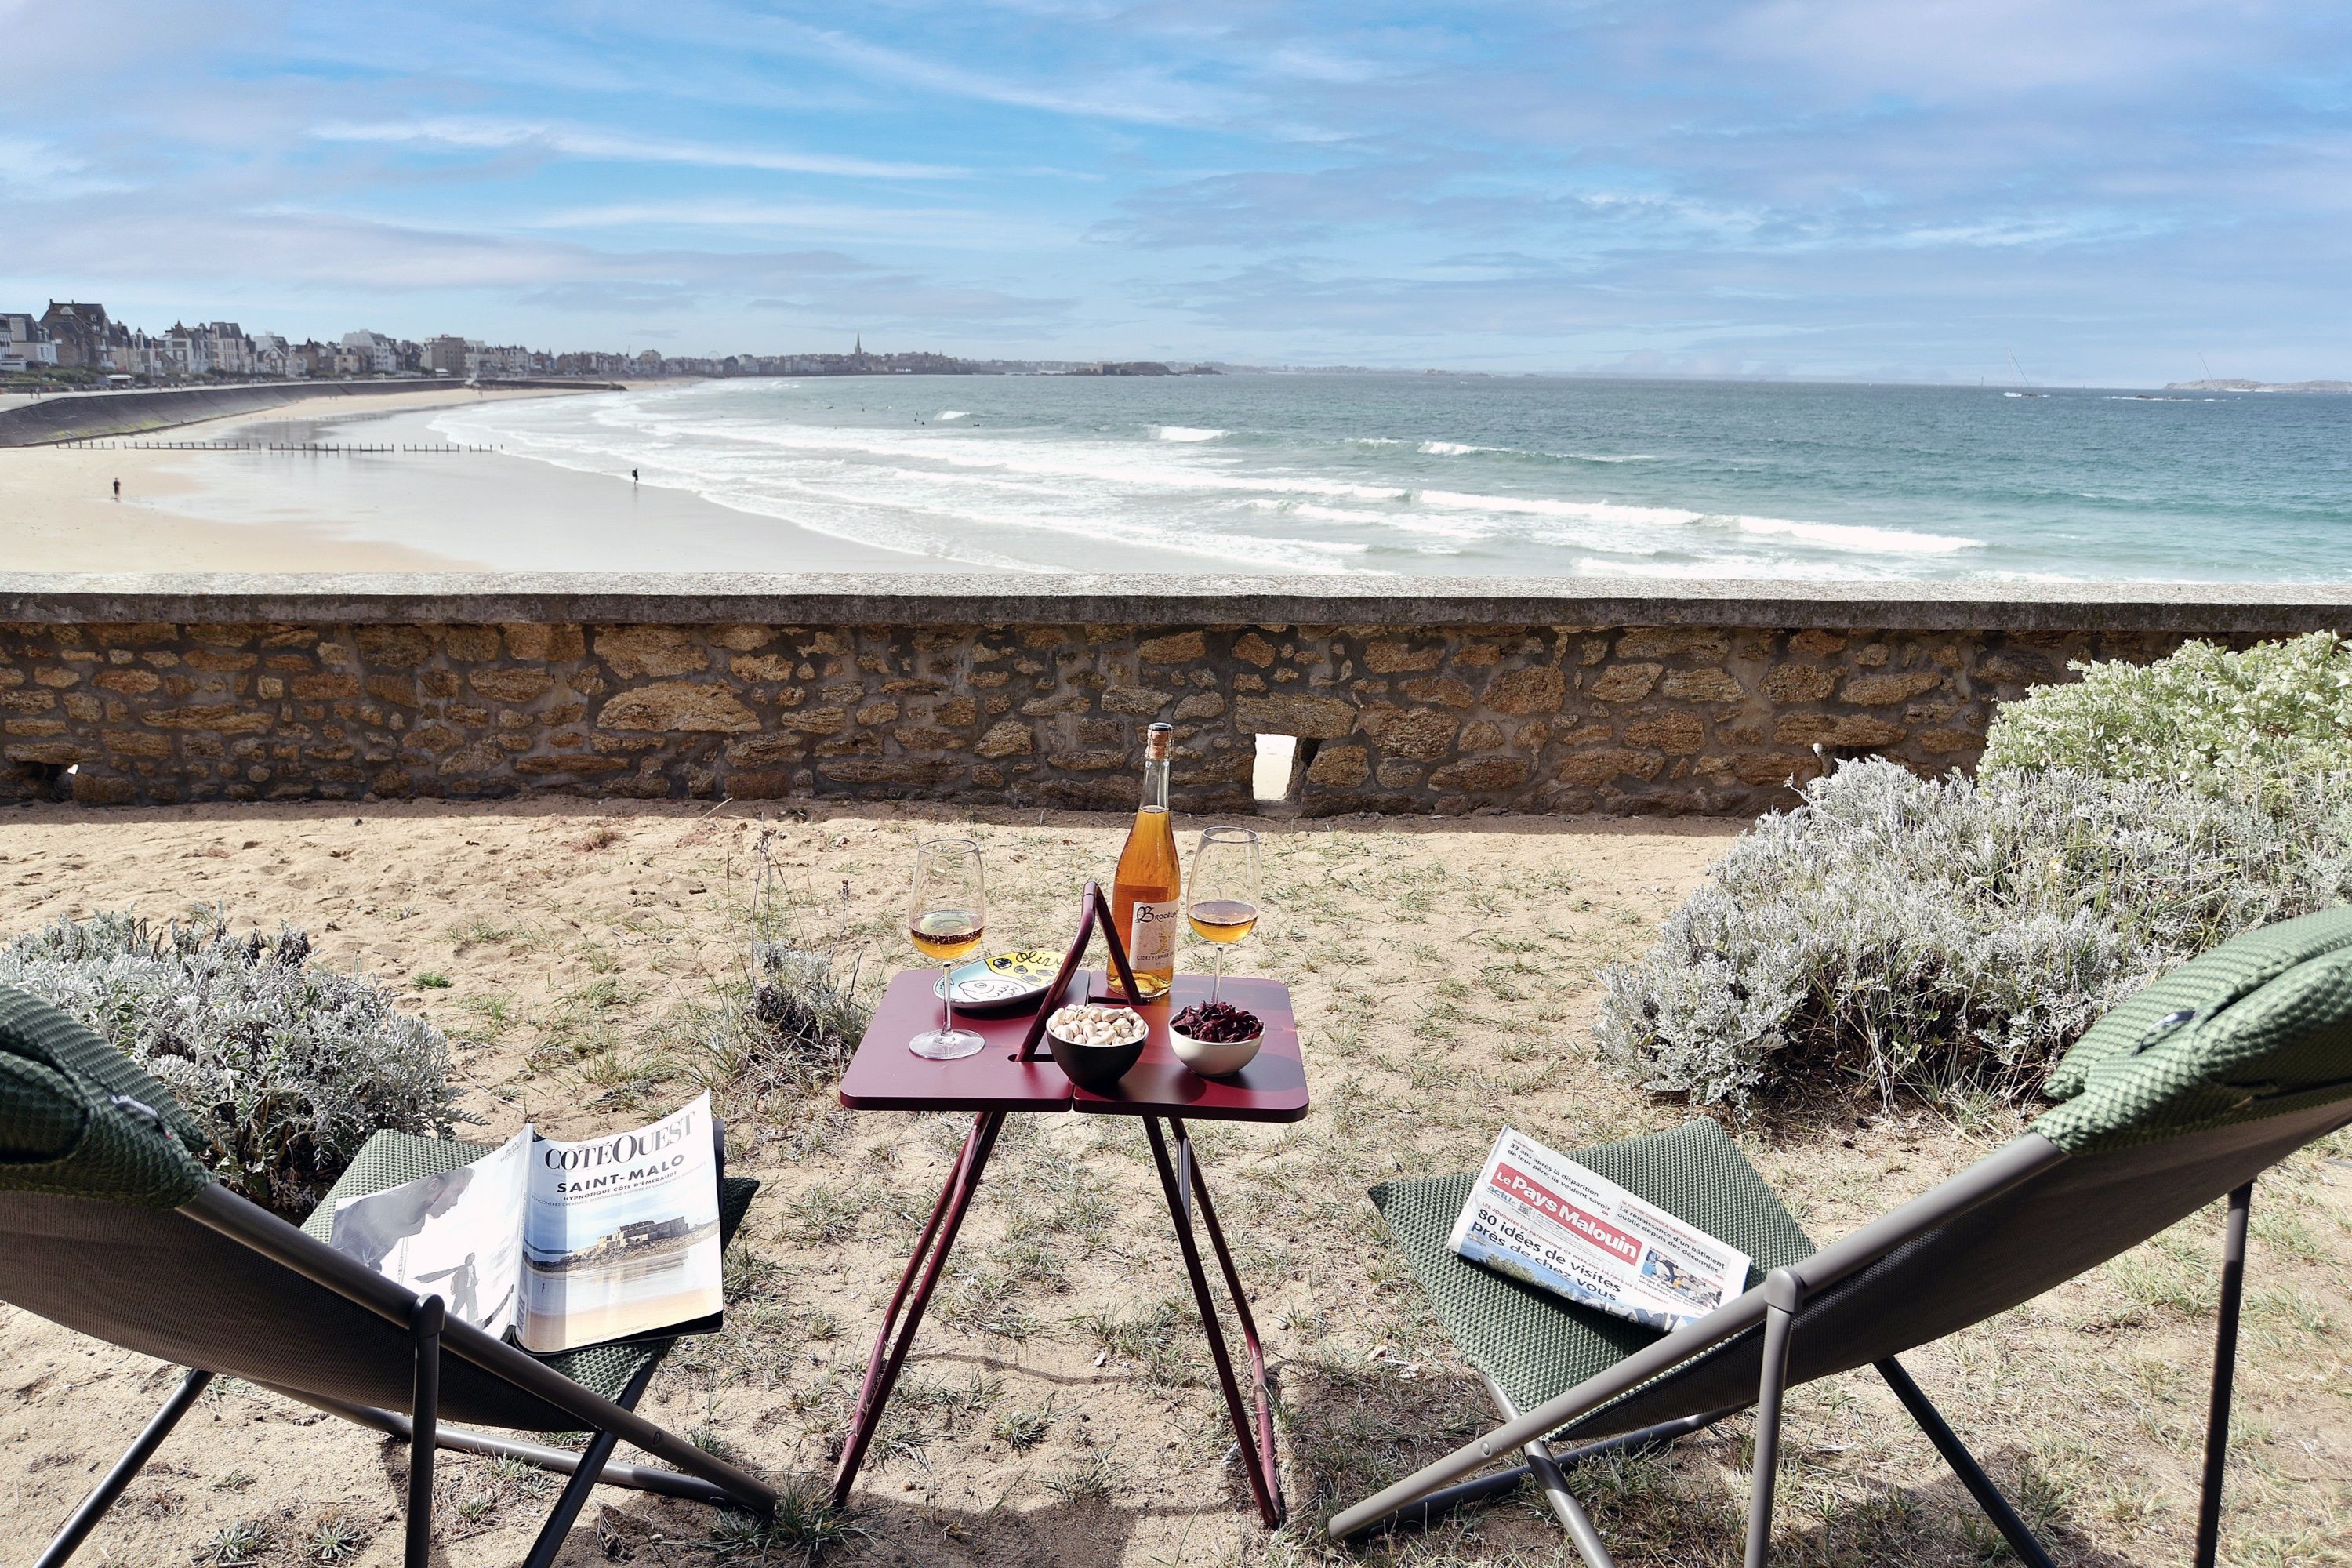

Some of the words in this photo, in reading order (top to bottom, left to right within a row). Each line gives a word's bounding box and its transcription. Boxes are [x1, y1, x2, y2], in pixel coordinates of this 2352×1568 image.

[557, 1154, 684, 1193] SAINT-MALO
[563, 1189, 611, 1201] HYPNOTIQUE
[633, 1171, 677, 1187] D'ÉMERAUDE
[1518, 1155, 1531, 1166] leur
[1532, 1164, 1550, 1178] père,
[1561, 1181, 1588, 1199] veulent
[1588, 1197, 1611, 1211] savoir
[1520, 1149, 1532, 1159] ans
[1533, 1159, 1552, 1171] après
[1561, 1174, 1599, 1197] disparition
[1491, 1207, 1519, 1226] JOURNÉES
[1529, 1230, 1563, 1250] PATRIMOINE
[1496, 1171, 1511, 1186] Le
[1512, 1175, 1559, 1213] Pays
[1559, 1203, 1637, 1259] Malouin
[1617, 1213, 1640, 1228] oublié
[1642, 1225, 1666, 1243] depuis
[1668, 1240, 1680, 1251] des
[1682, 1248, 1719, 1274] décennies
[1619, 1205, 1628, 1214] La
[1629, 1212, 1671, 1238] renaissance
[1672, 1236, 1690, 1249] d'un
[1691, 1245, 1726, 1269] bâtiment
[1471, 1221, 1506, 1247] près
[1510, 1244, 1530, 1258] de
[1534, 1257, 1572, 1279] chez
[1577, 1277, 1617, 1301] vous
[1478, 1208, 1497, 1226] 80
[1500, 1221, 1541, 1252] idées
[1545, 1250, 1566, 1265] de
[1570, 1261, 1621, 1293] visites
